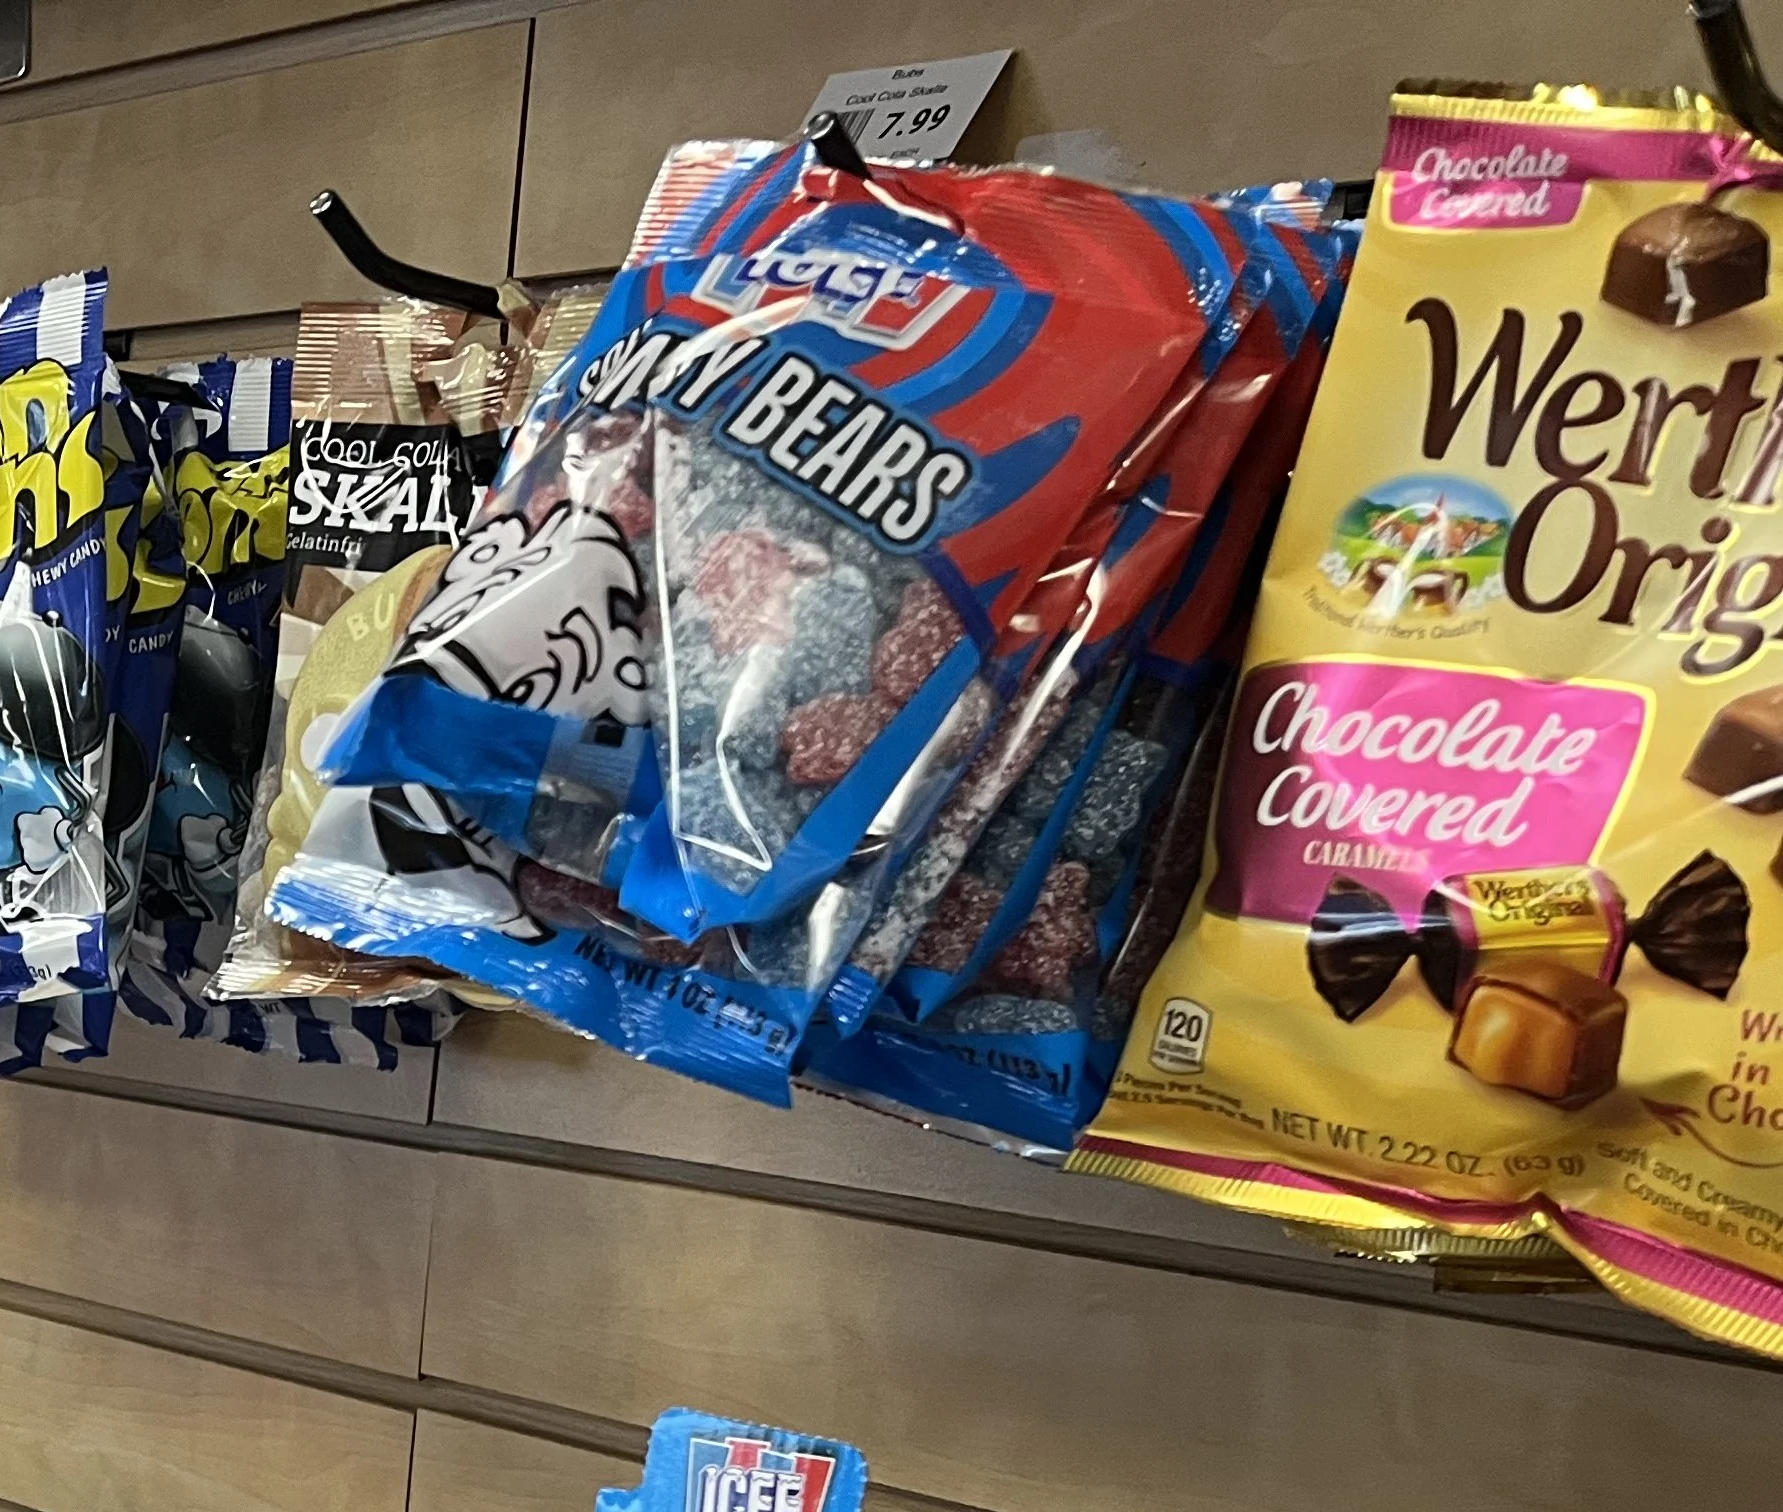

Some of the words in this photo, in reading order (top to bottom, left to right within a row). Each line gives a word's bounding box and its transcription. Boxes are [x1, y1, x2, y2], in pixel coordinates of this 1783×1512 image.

[878, 104, 950, 139] 7.99
[1412, 145, 1568, 182] Chocolate
[1420, 182, 1551, 220] Covered
[305, 434, 380, 467] COOL
[726, 355, 970, 542] BEARS
[68, 535, 107, 571] CANDY
[129, 630, 173, 654] CANDY
[1252, 680, 1597, 778] Chocolate
[1255, 766, 1534, 848] Covered
[1164, 1009, 1204, 1042] 120
[1731, 1050, 1771, 1086] in
[1271, 1107, 1319, 1142] NET
[1378, 1134, 1439, 1169] 2.22
[1651, 1158, 1694, 1193] and
[1622, 1172, 1711, 1228] Covered
